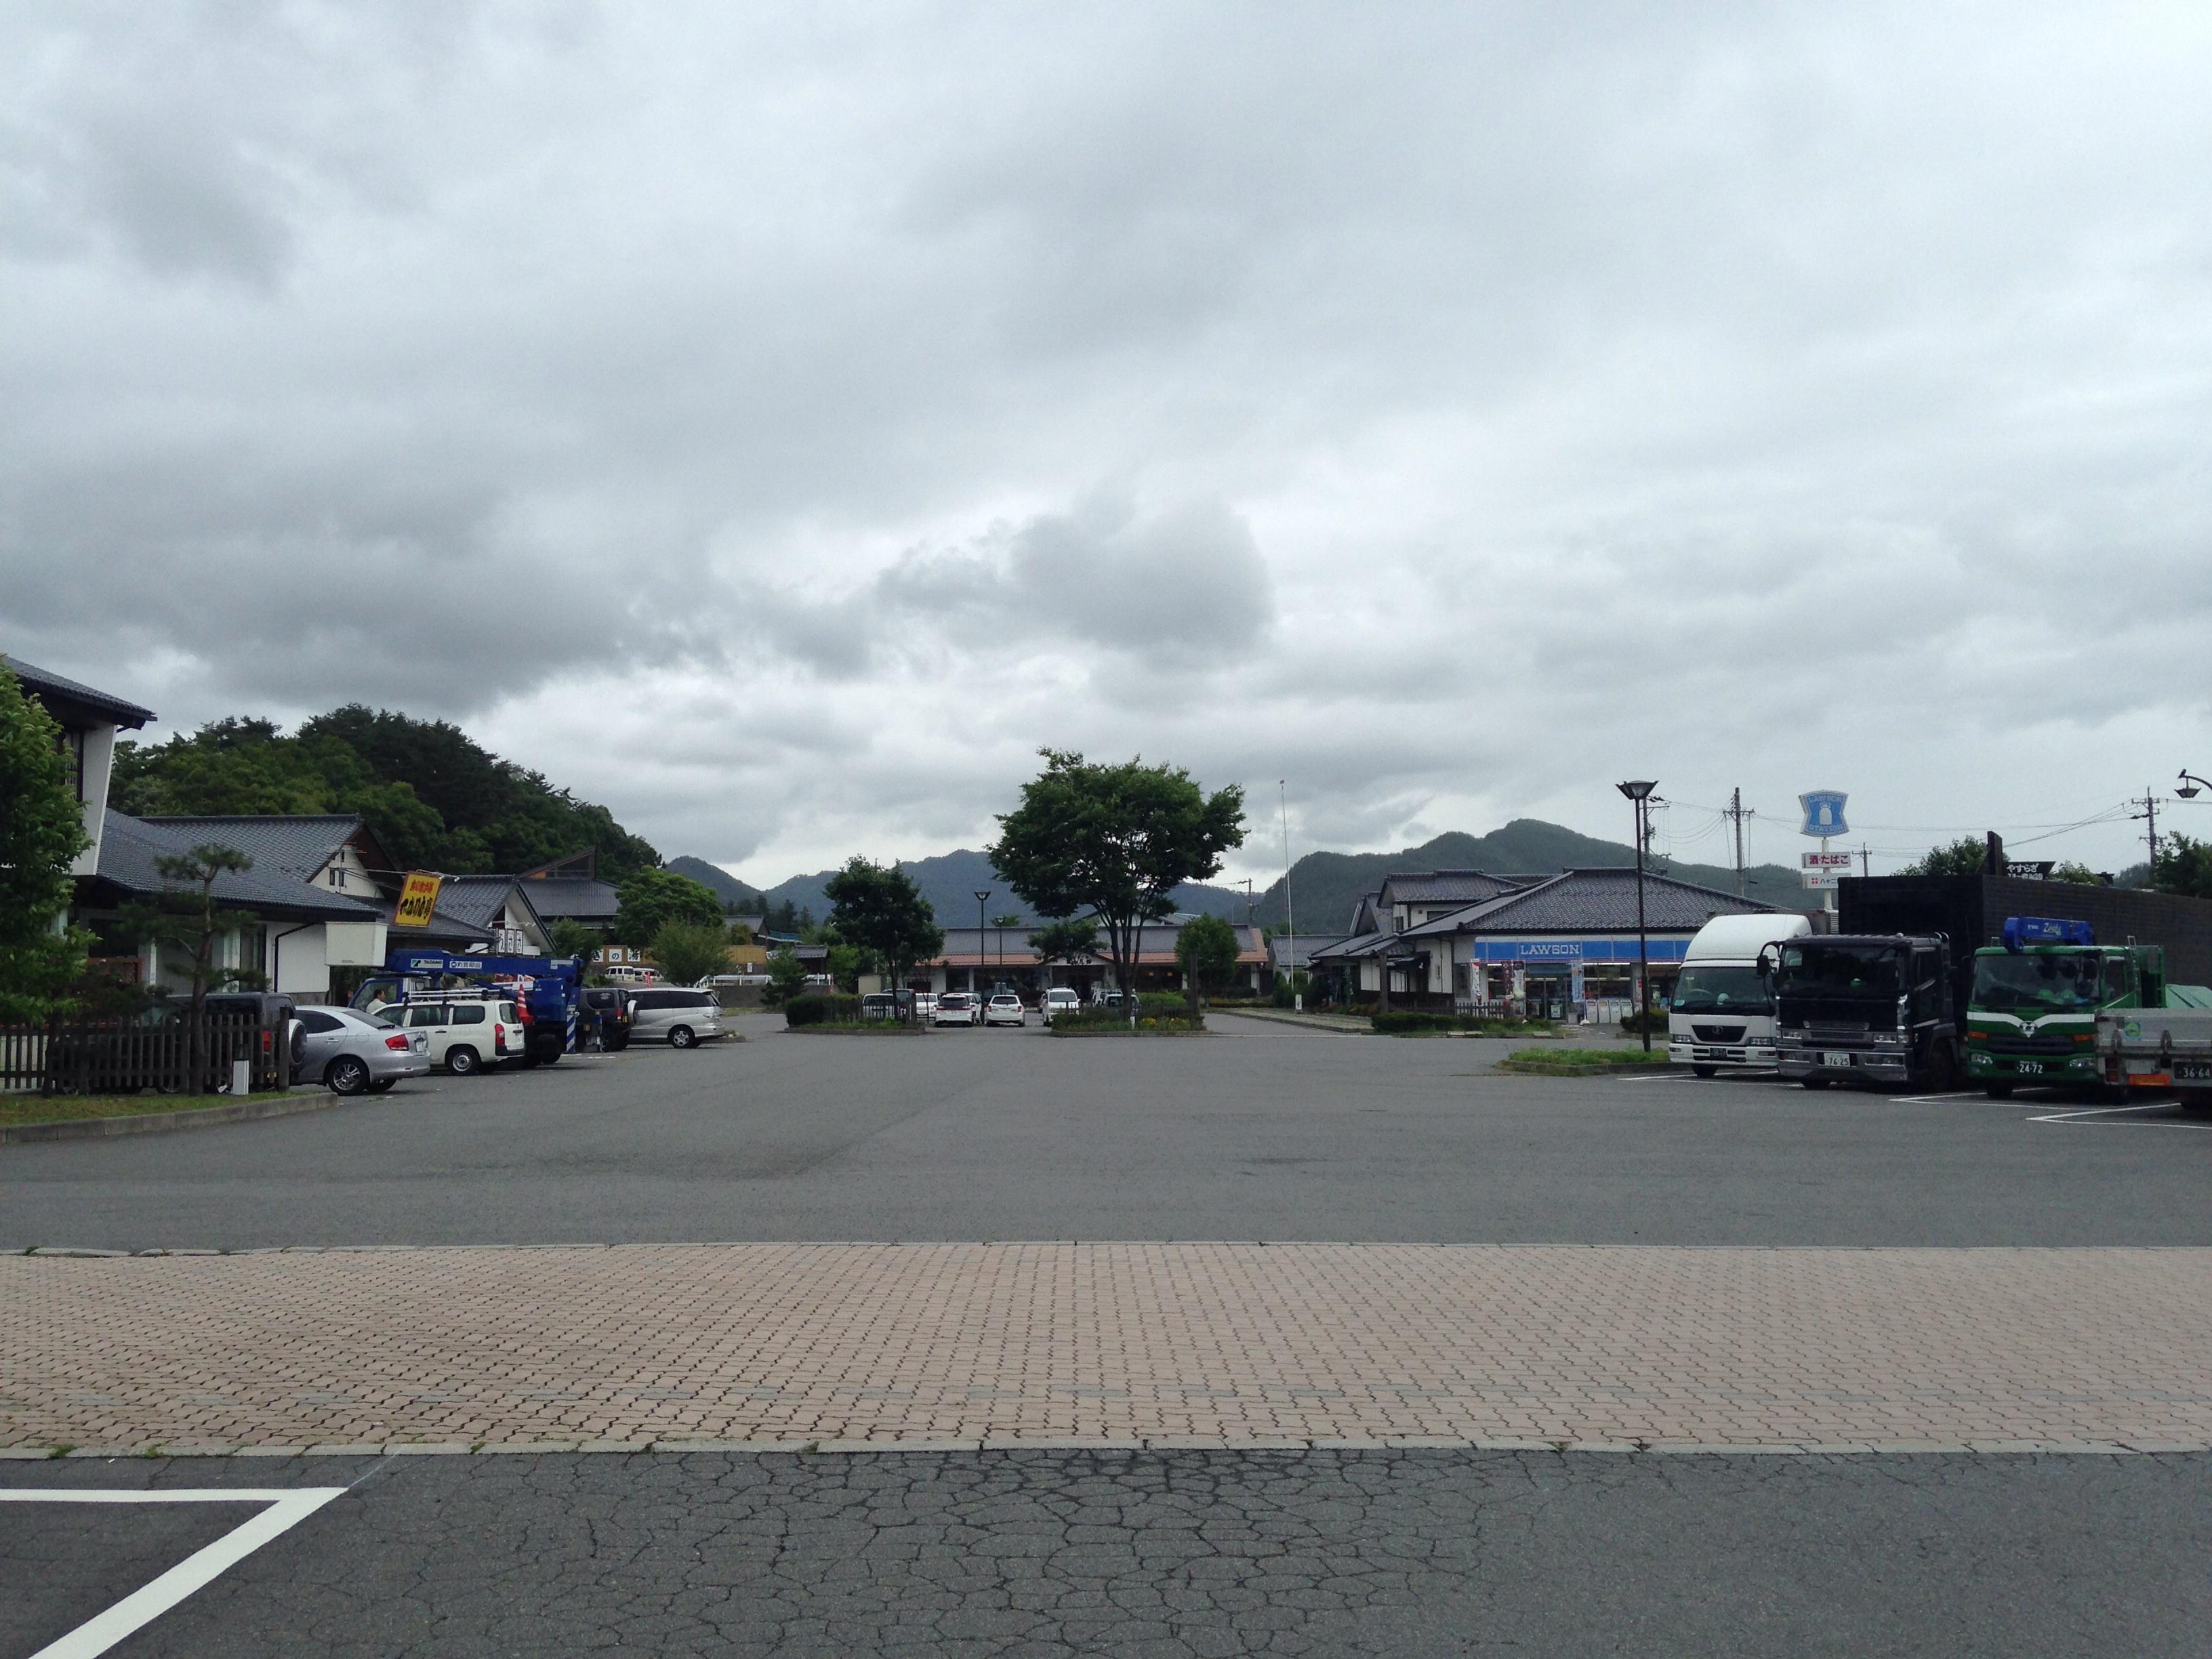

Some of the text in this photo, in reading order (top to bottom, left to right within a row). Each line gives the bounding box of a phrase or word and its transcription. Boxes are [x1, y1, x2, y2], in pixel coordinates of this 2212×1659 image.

[1808, 795, 1843, 803] LAWSON
[1809, 824, 1844, 832] STATION
[1809, 855, 1849, 865] 酒・たばこ
[1520, 944, 1580, 955] LAWSON
